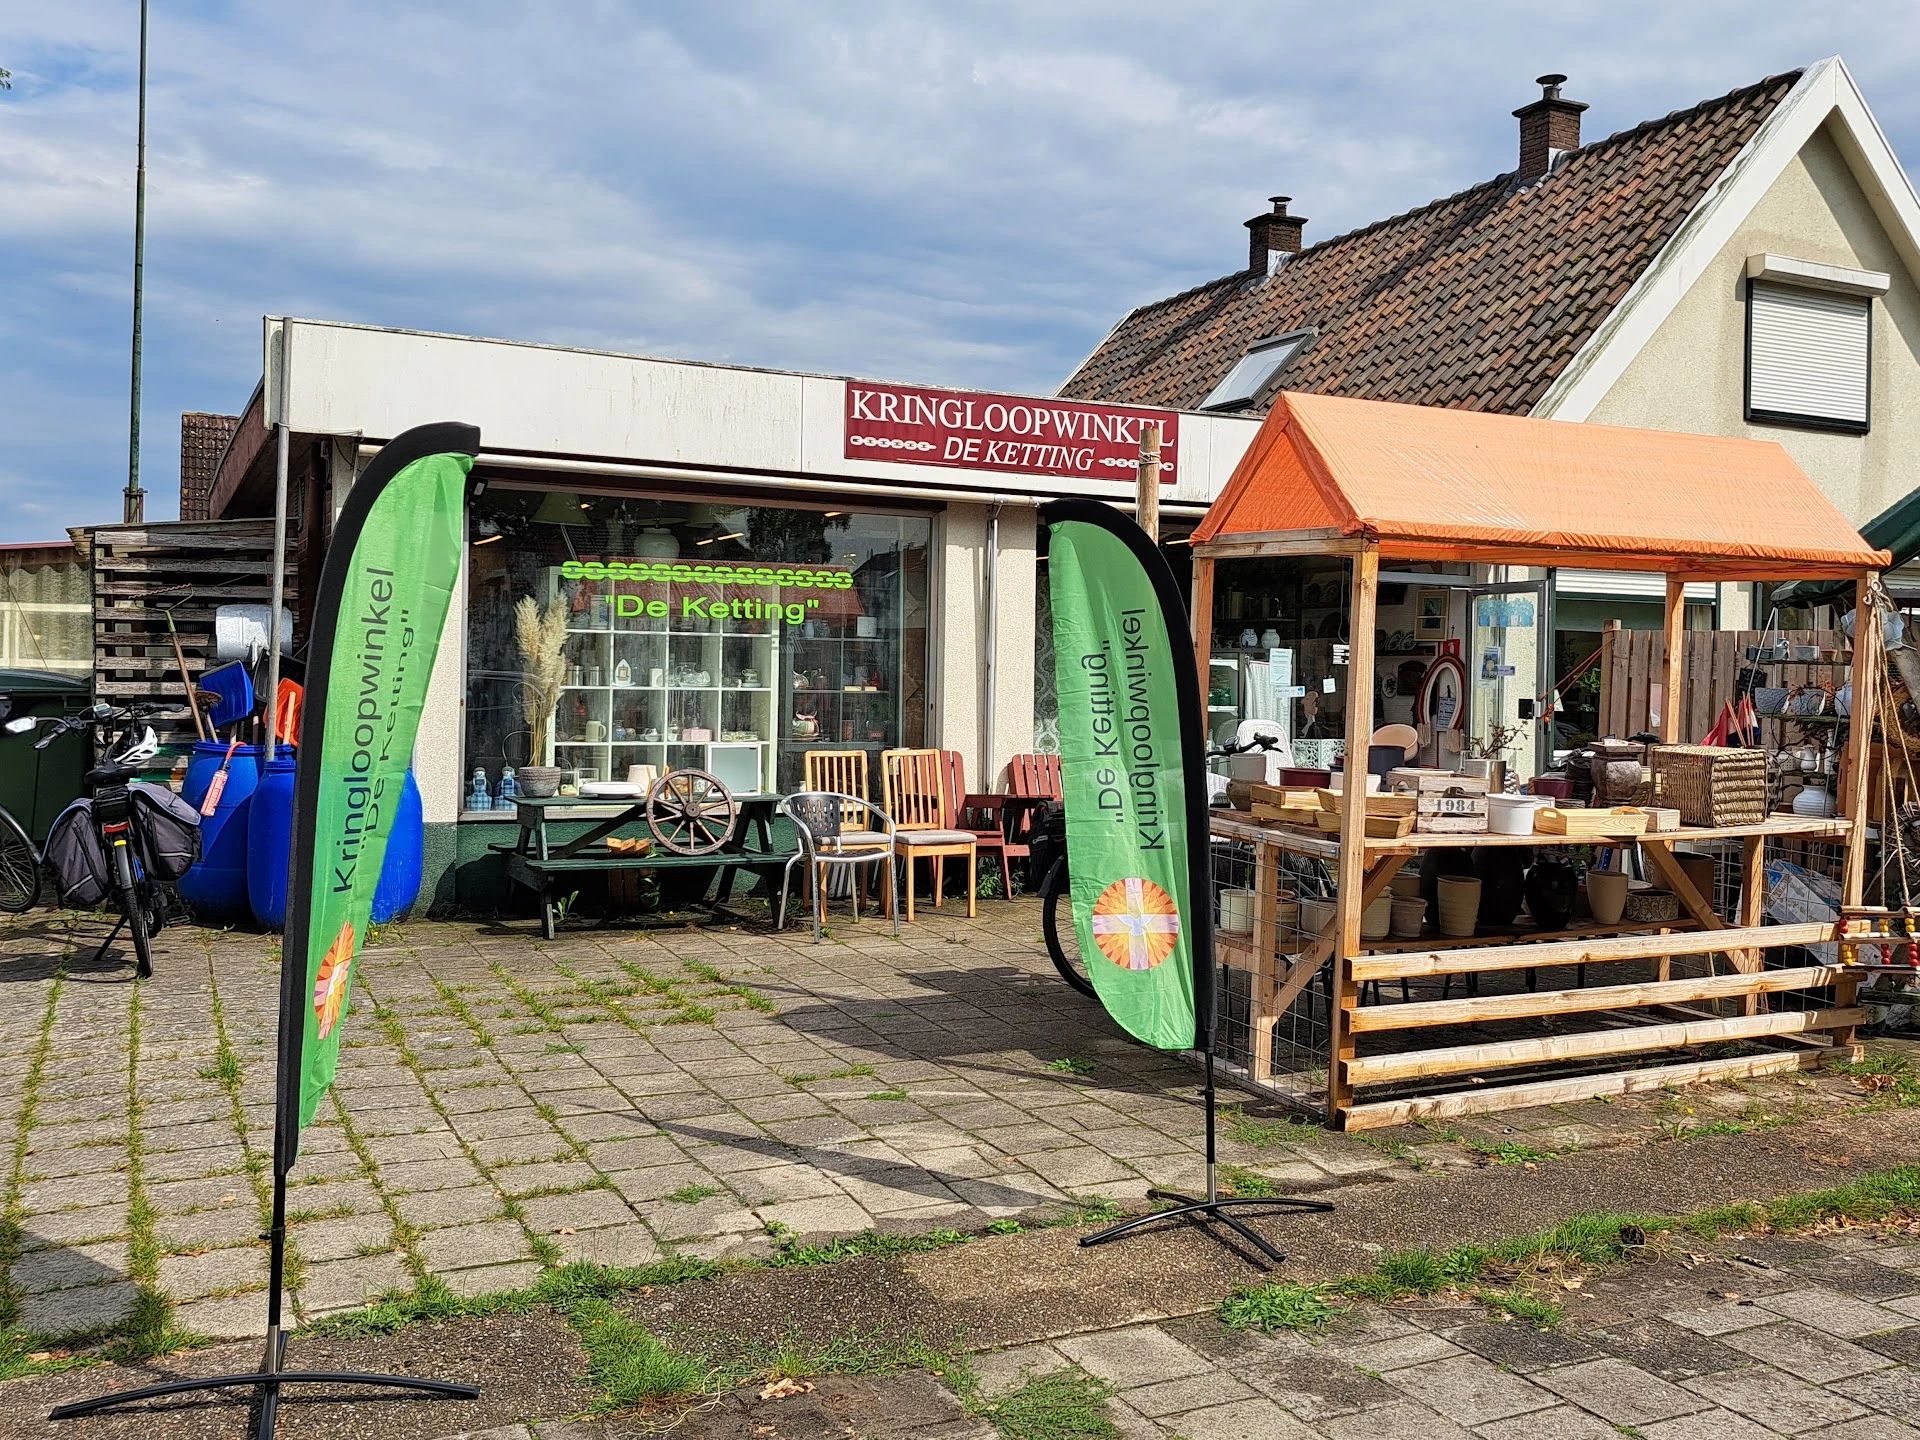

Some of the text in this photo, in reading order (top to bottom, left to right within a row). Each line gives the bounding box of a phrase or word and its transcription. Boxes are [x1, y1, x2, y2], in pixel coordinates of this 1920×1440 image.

[943, 436, 1096, 471] DE KETTING
[605, 595, 820, 625] "De Ketting"
[333, 567, 394, 893] Kringloopwinkel
[1436, 799, 1476, 812] 1984
